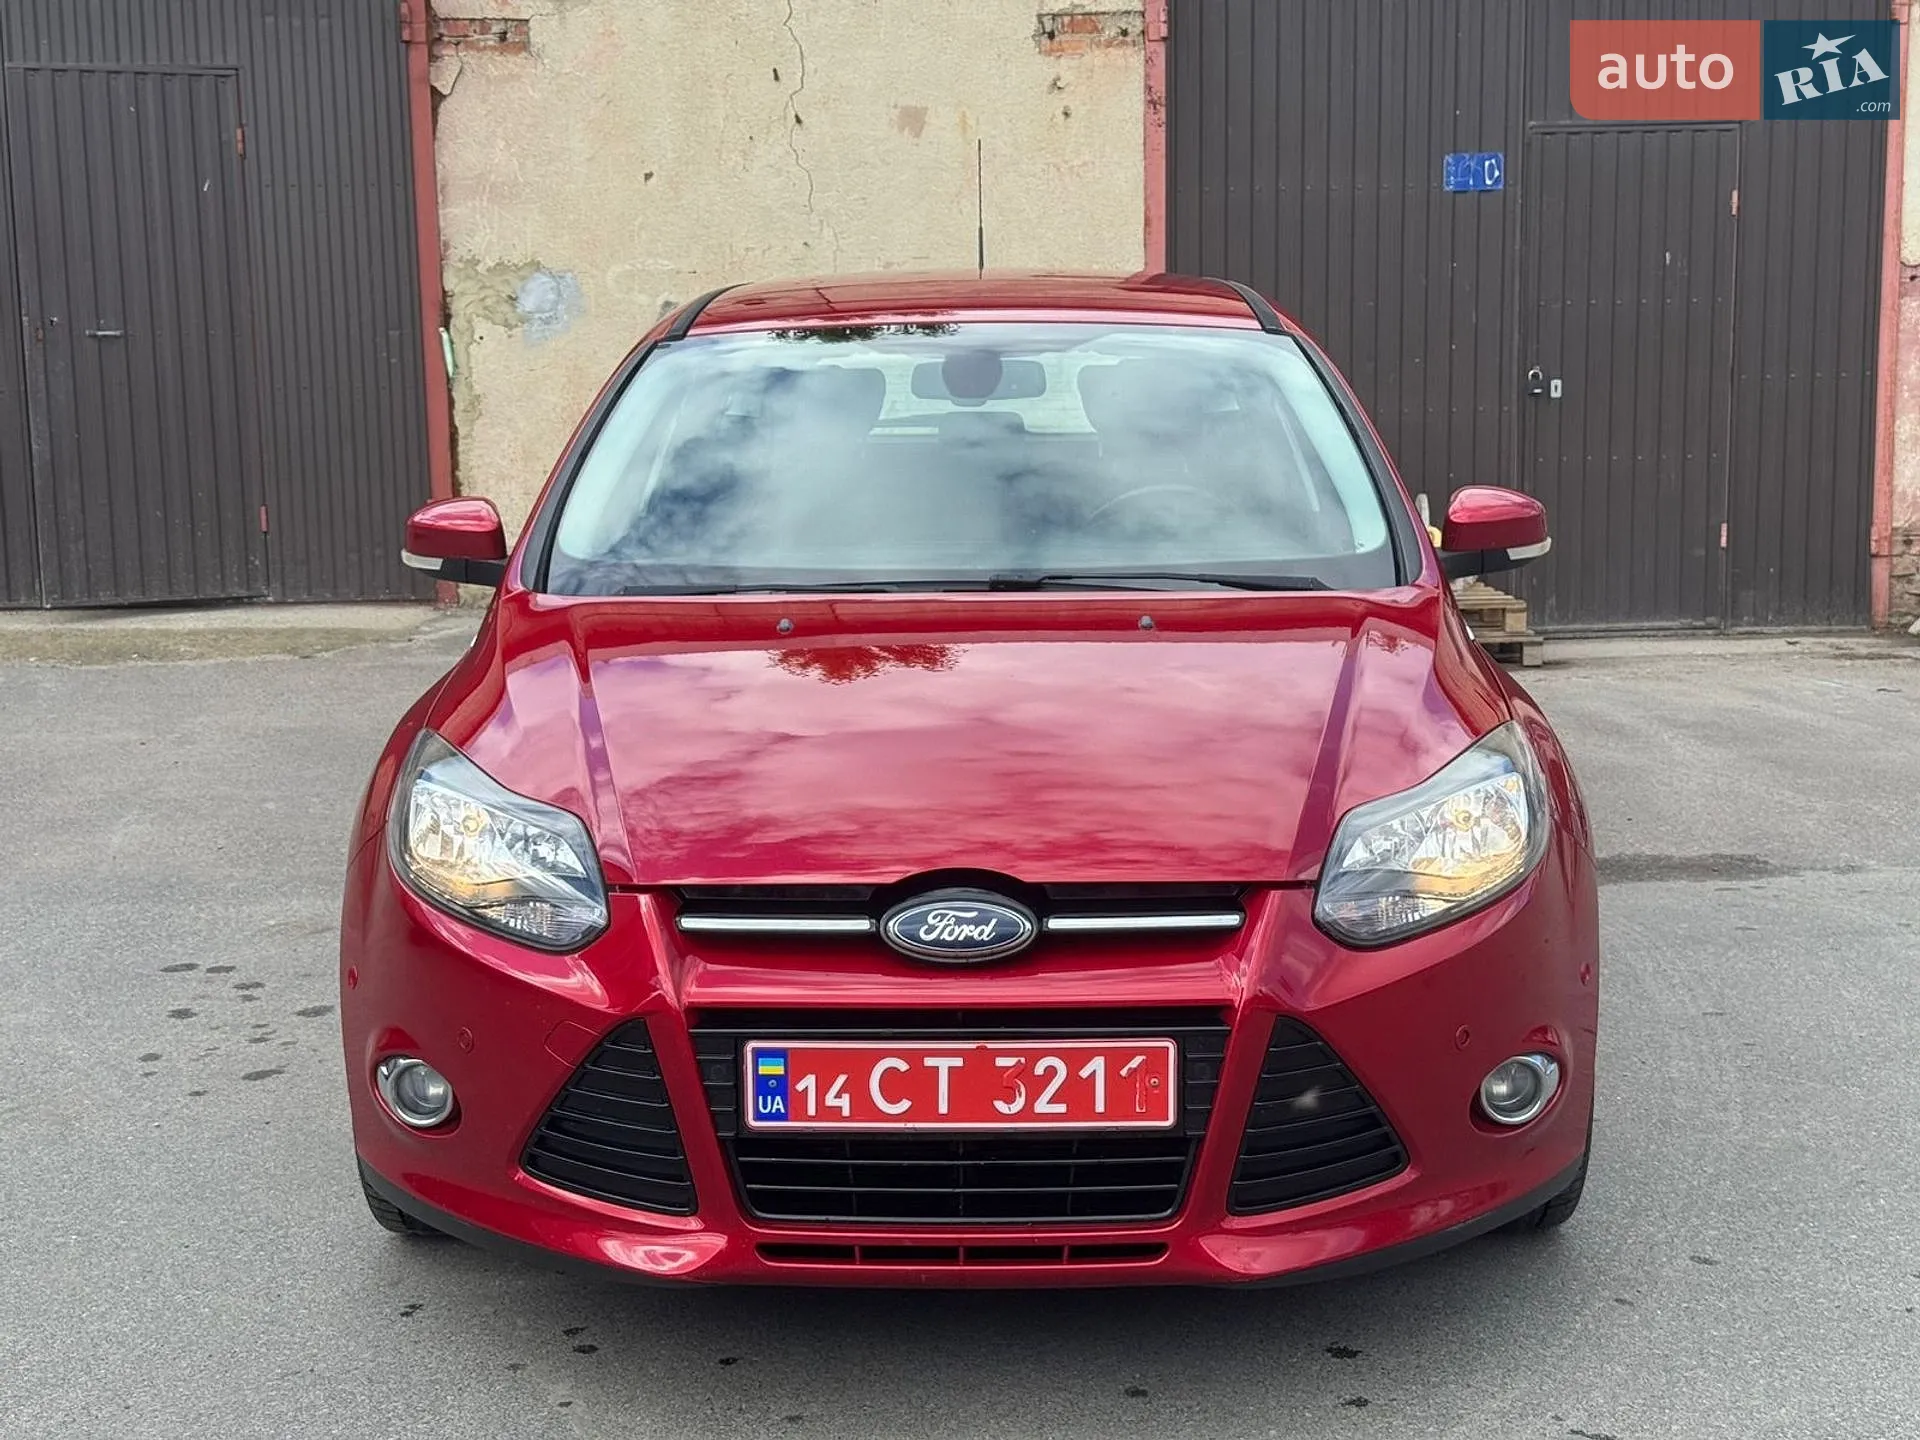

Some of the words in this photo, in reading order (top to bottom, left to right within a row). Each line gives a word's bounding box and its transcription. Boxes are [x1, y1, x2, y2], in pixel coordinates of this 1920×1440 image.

[919, 909, 998, 941] Ford
[795, 1073, 851, 1117] 14
[868, 1056, 964, 1115] CT
[992, 1055, 1147, 1115] 3211
[758, 1095, 785, 1114] UA
